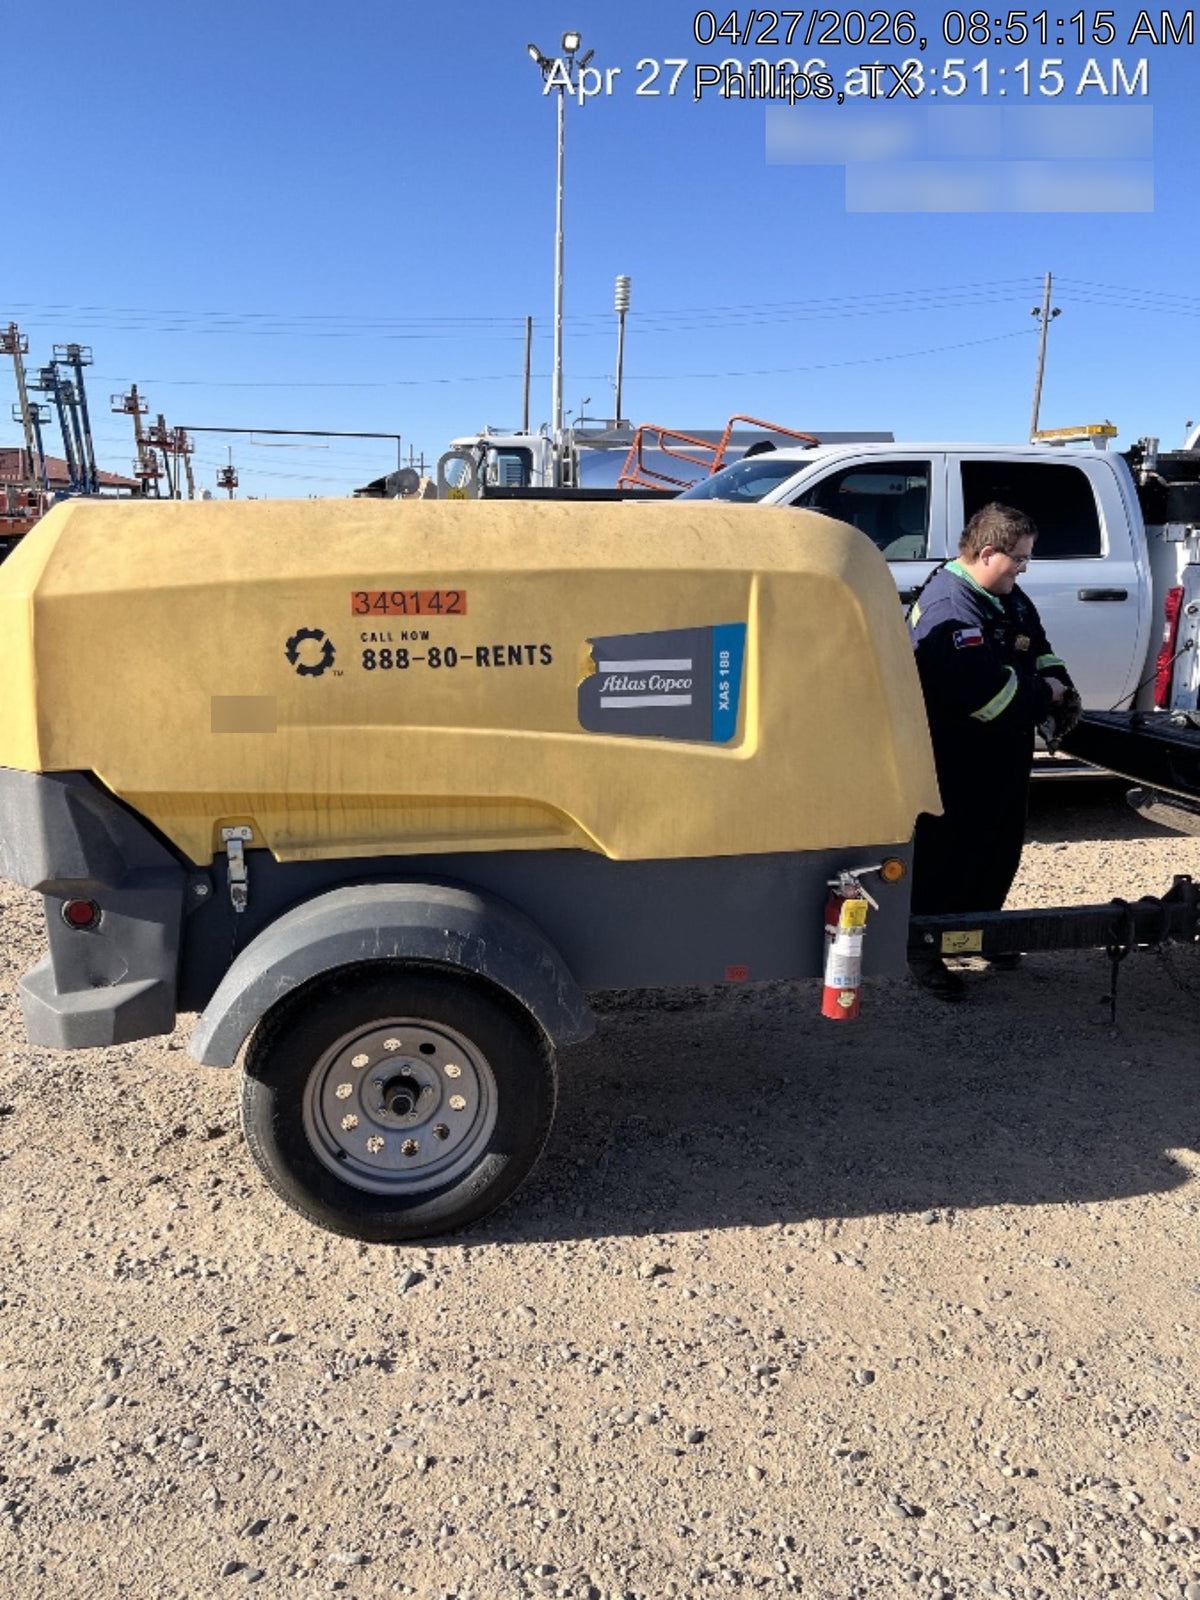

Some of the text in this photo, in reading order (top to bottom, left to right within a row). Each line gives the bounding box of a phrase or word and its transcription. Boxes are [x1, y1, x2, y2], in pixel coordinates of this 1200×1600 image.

[354, 591, 461, 615] 349142
[360, 630, 430, 642] CALL NOW
[362, 643, 553, 670] 888-80-RENTS
[599, 674, 693, 693] Atlas Copco
[718, 650, 730, 711] XAS 188
